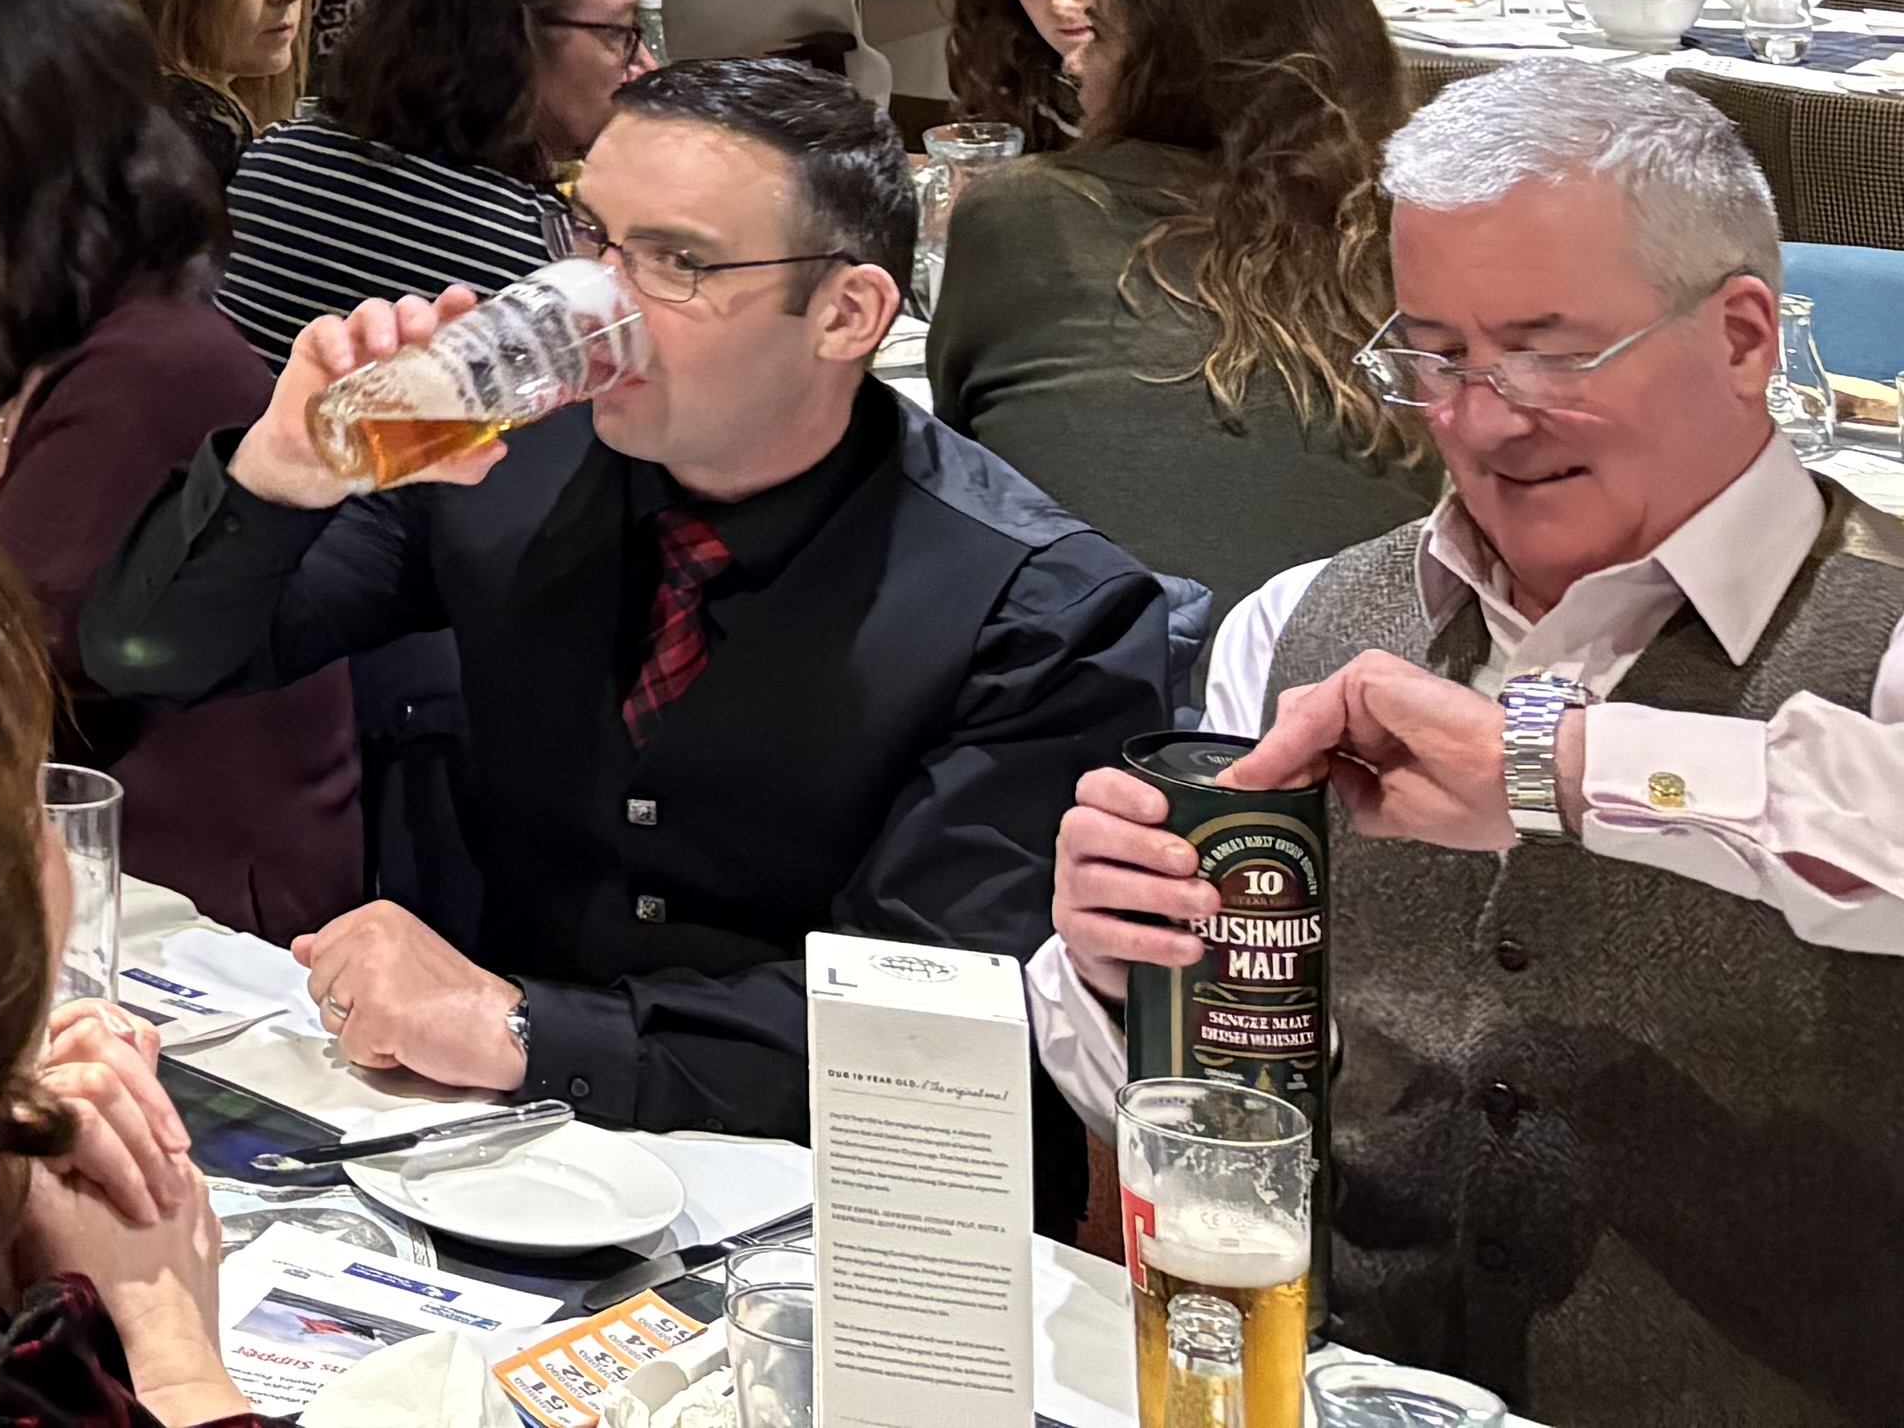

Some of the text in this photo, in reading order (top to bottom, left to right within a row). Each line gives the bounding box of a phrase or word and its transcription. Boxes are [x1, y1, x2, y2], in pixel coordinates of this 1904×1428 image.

[1243, 870, 1283, 895] 10
[1228, 949, 1298, 980] MALT
[562, 1365, 601, 1395] 52
[594, 1351, 632, 1381] 53
[530, 1382, 568, 1410] 51
